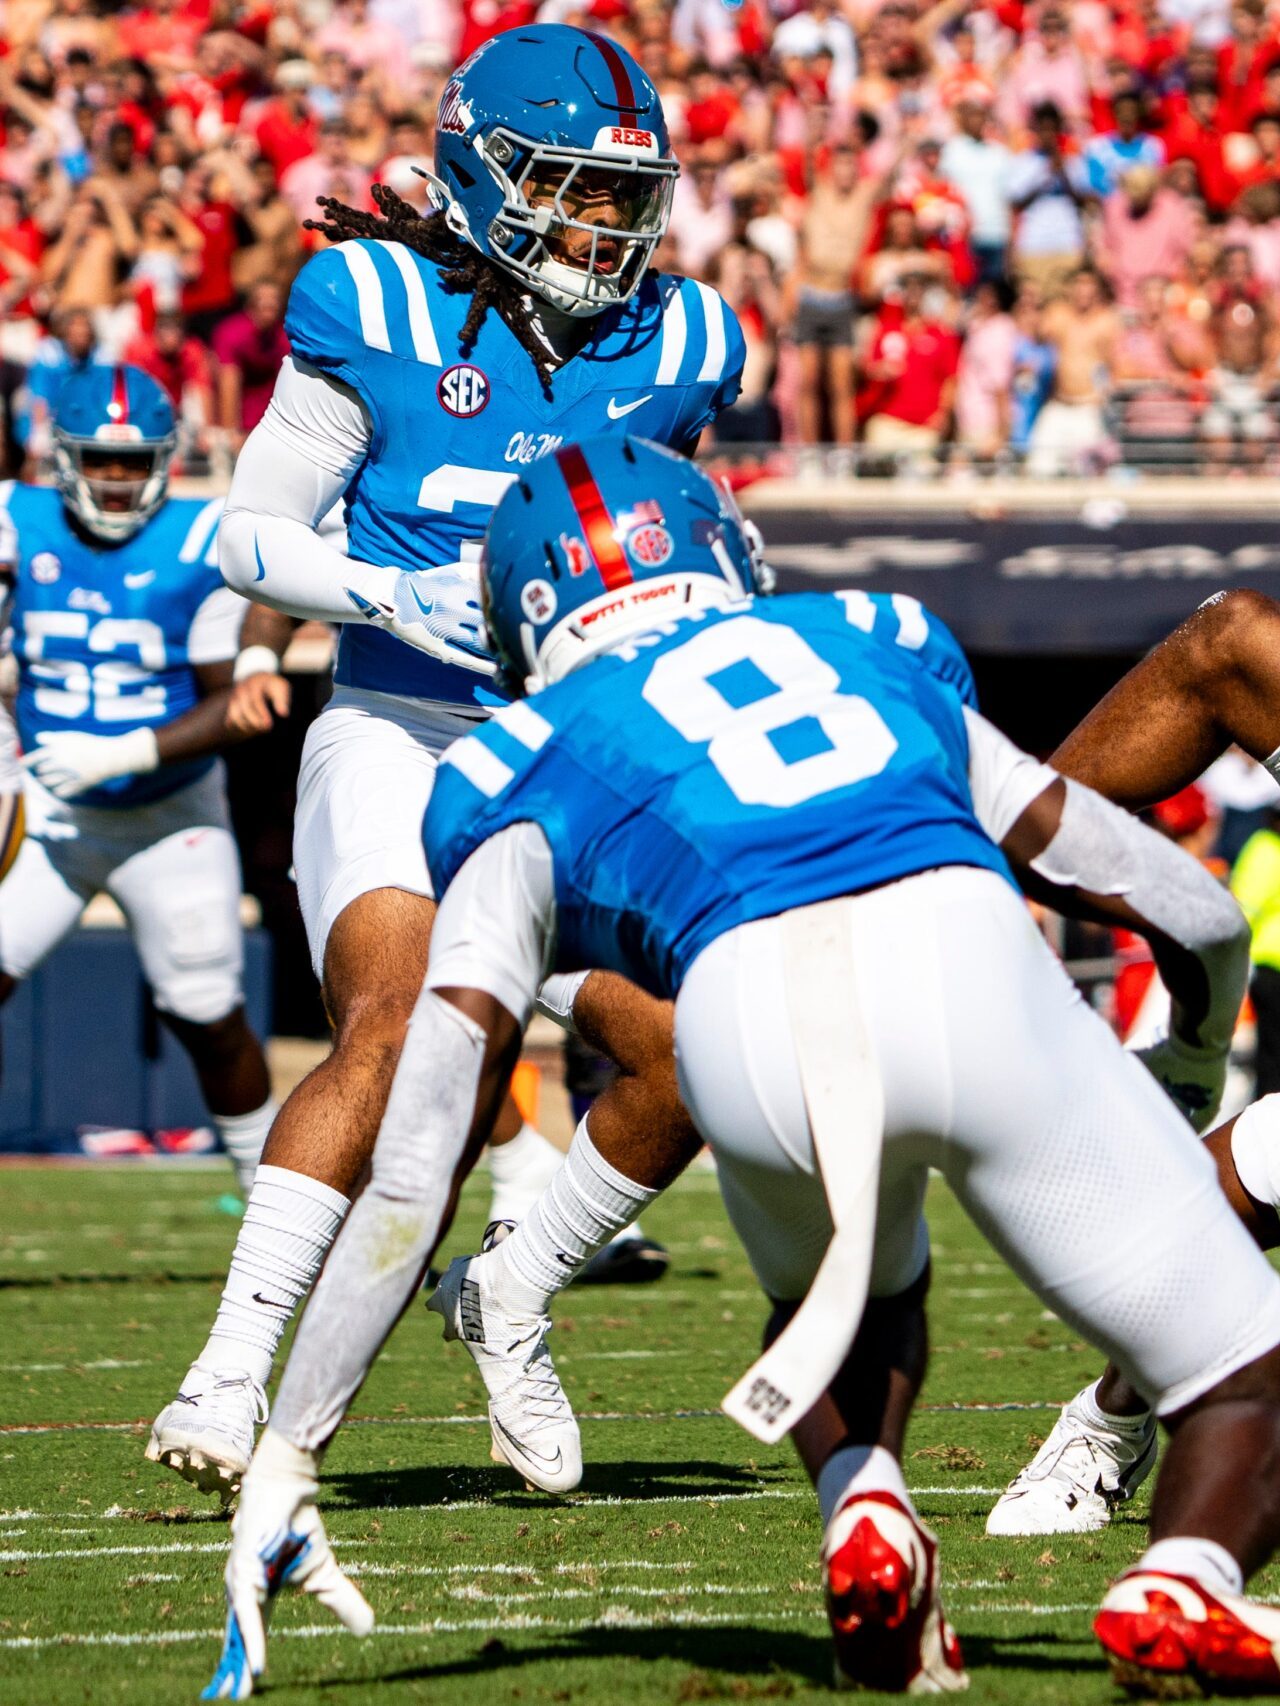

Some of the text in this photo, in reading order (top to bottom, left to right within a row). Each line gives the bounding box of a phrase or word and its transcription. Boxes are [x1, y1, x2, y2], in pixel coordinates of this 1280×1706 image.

[611, 128, 652, 148] REBS
[441, 366, 486, 415] SEC
[504, 431, 537, 464] Ole
[23, 611, 167, 722] 52
[642, 615, 899, 808] 8
[460, 1277, 486, 1344] NIKE
